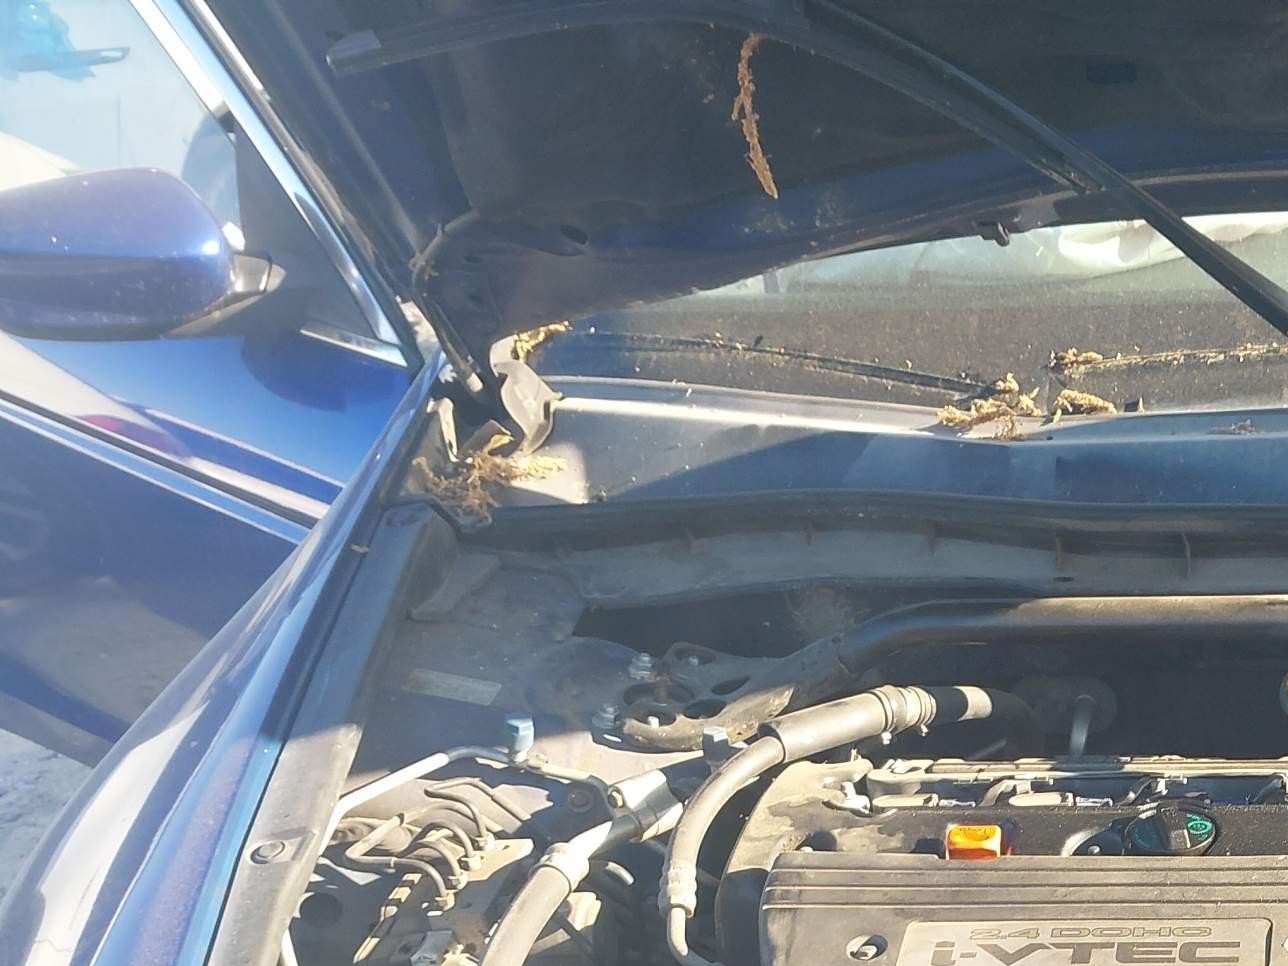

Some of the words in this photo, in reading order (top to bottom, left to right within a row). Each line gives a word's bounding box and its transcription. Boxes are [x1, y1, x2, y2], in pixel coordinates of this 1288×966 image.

[969, 926, 1041, 941] 2.4
[1050, 925, 1213, 939] DOHC
[930, 940, 1241, 966] i-VTEC
